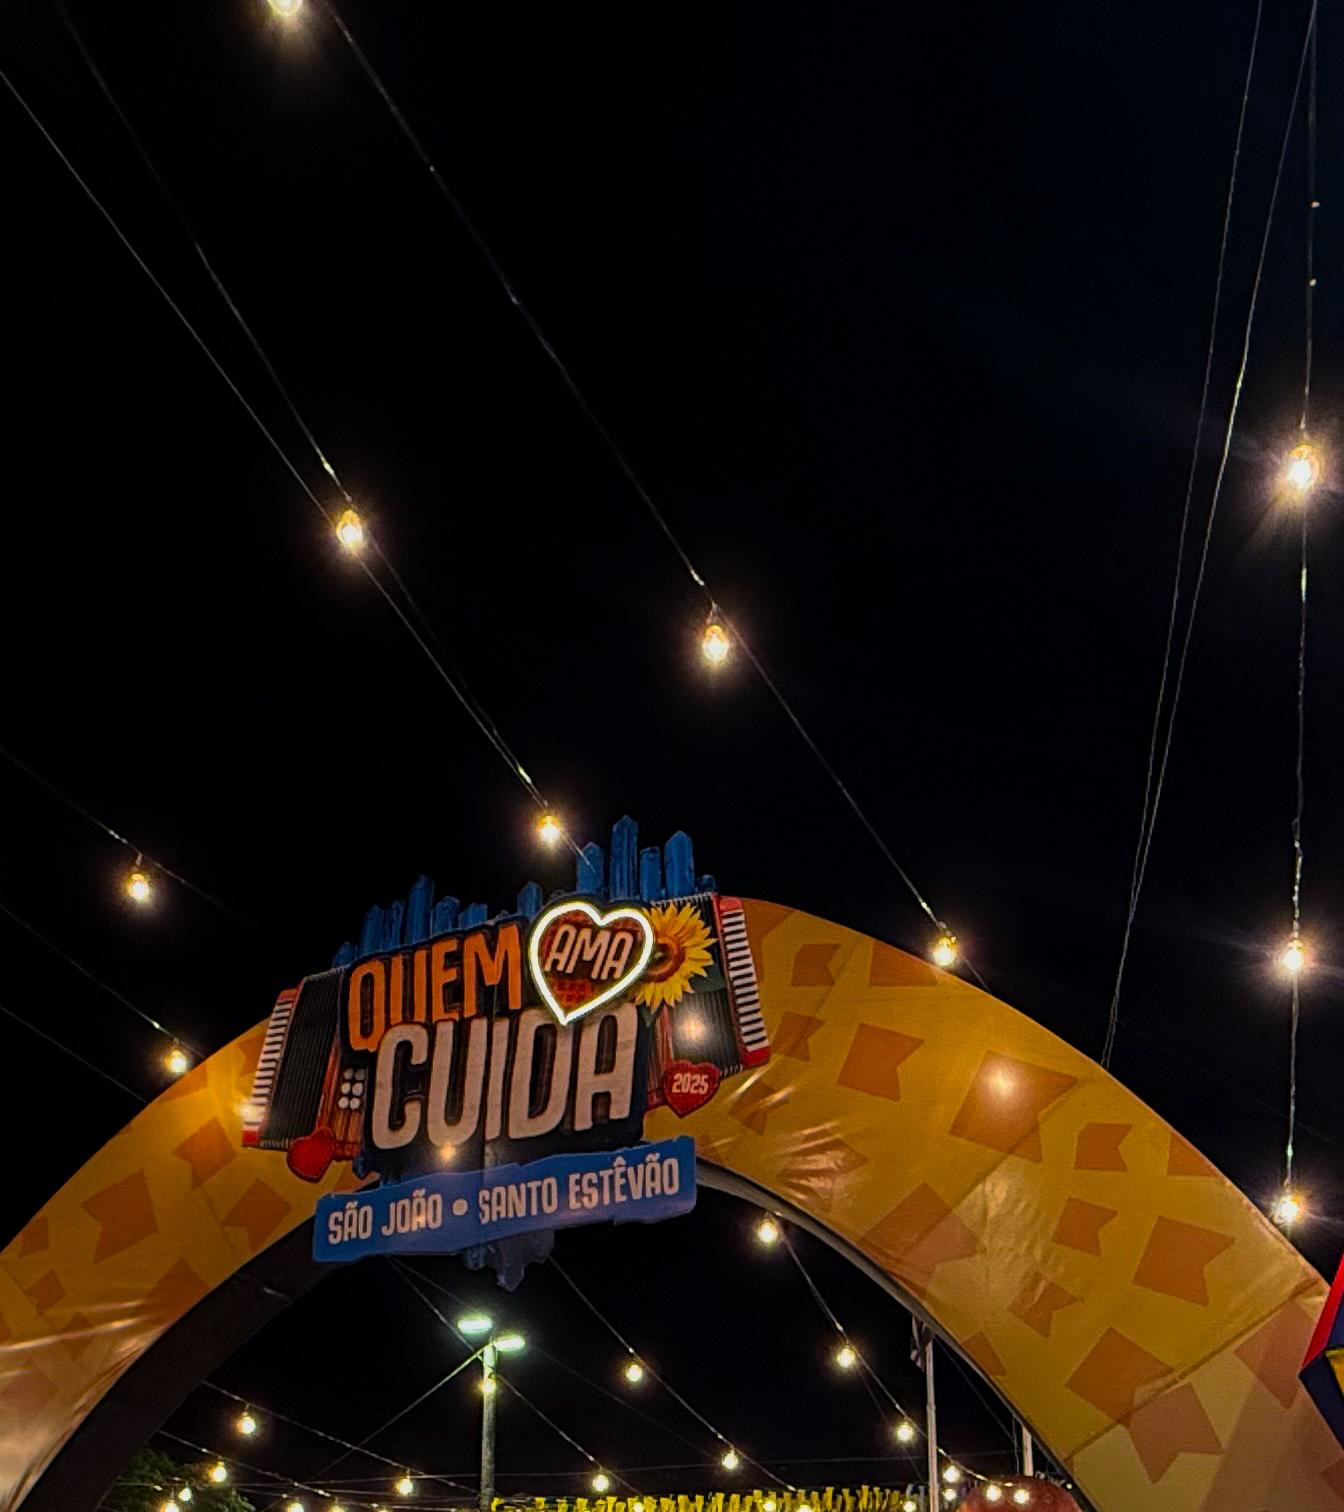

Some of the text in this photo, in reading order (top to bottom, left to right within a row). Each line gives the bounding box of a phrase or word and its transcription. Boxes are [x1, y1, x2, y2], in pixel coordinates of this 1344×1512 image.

[348, 923, 634, 1052] QUEM AMA
[372, 1002, 638, 1149] CUIDA
[672, 1072, 709, 1095] 2025
[327, 1152, 680, 1245] SÃO JOÃO SANTO ESTÊVÃO
